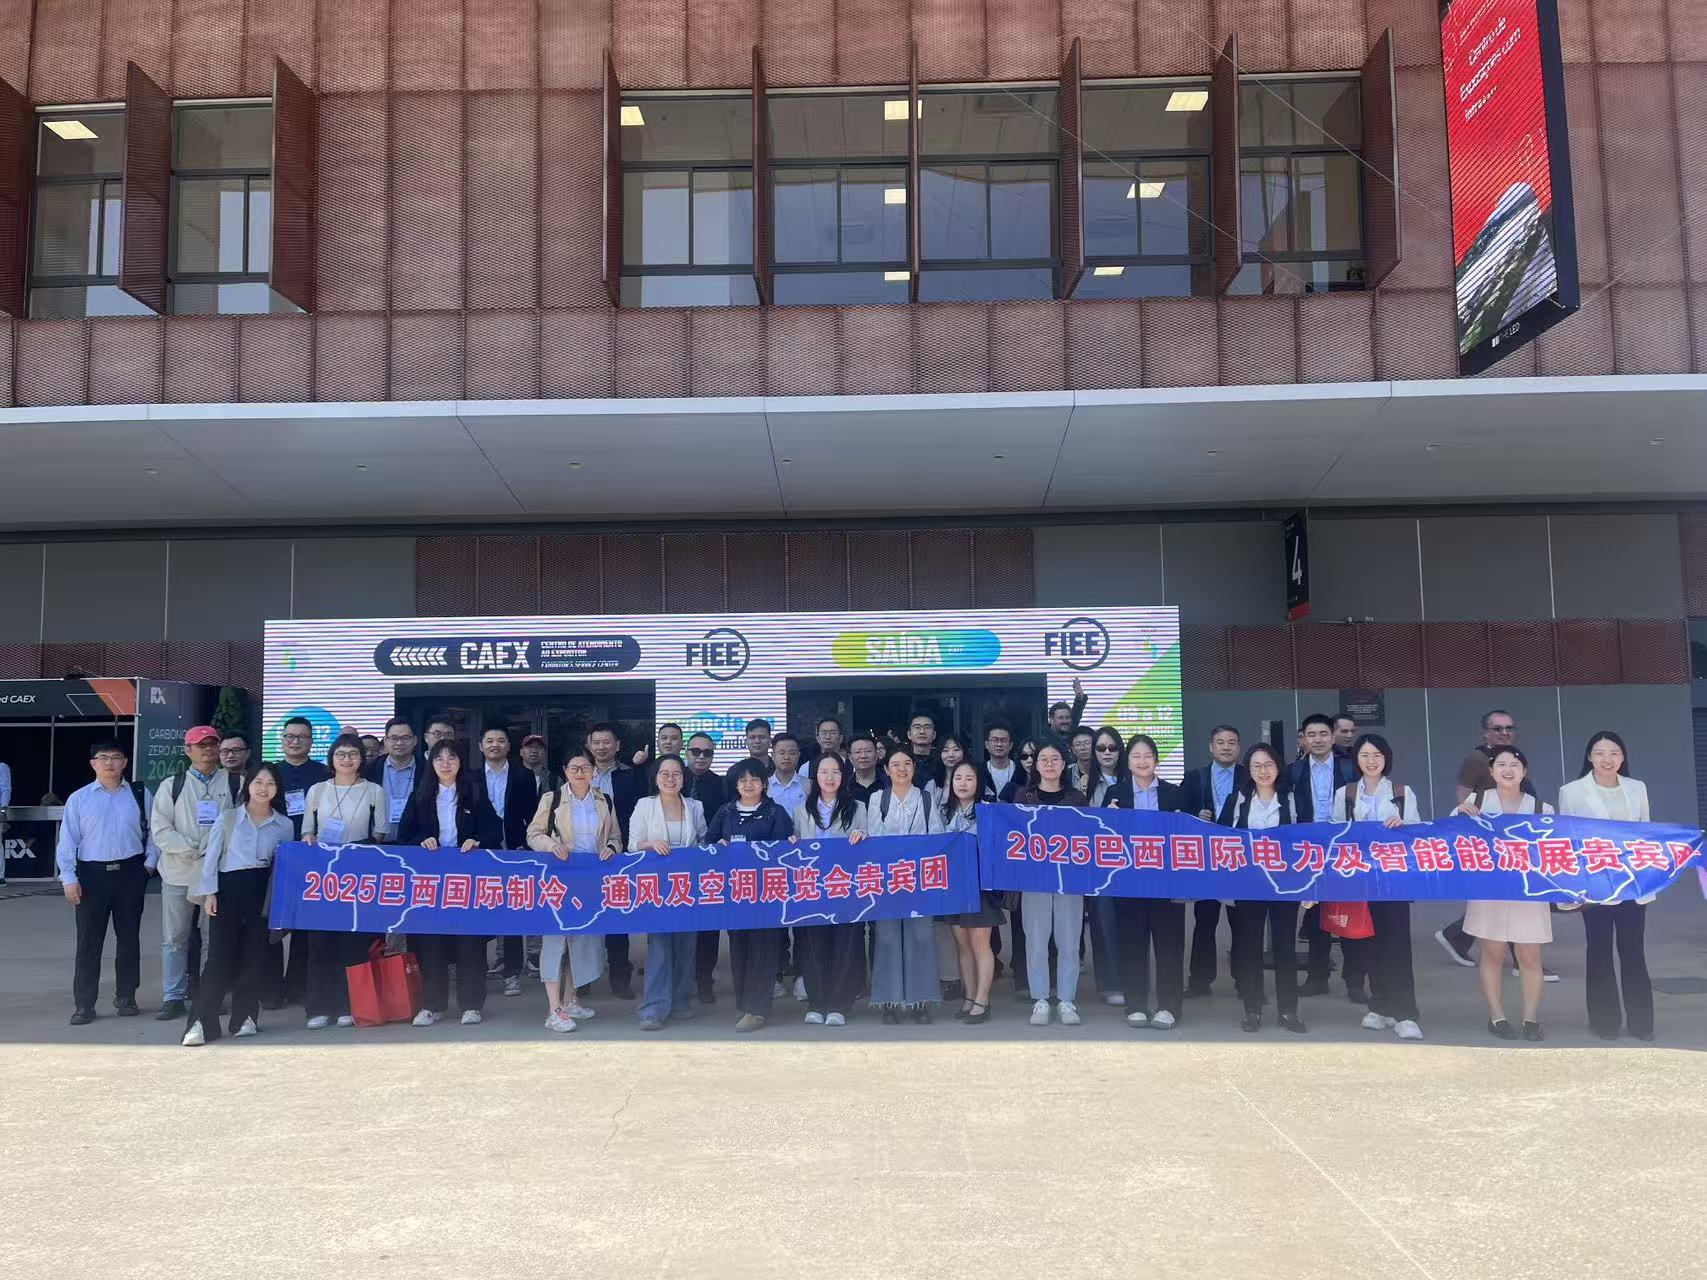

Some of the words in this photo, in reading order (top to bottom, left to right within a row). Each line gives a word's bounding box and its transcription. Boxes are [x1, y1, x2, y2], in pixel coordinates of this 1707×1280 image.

[1292, 535, 1302, 586] 4
[460, 641, 530, 670] CAEX
[686, 643, 740, 666] FIEE
[1045, 632, 1100, 656] FIEE
[10, 694, 36, 704] CAEX
[150, 687, 166, 704] RX
[148, 745, 170, 756] ZERO
[5, 838, 36, 859] RX
[302, 854, 949, 911] 2025巴西国际制冷、通风及空调展览会贵宾团
